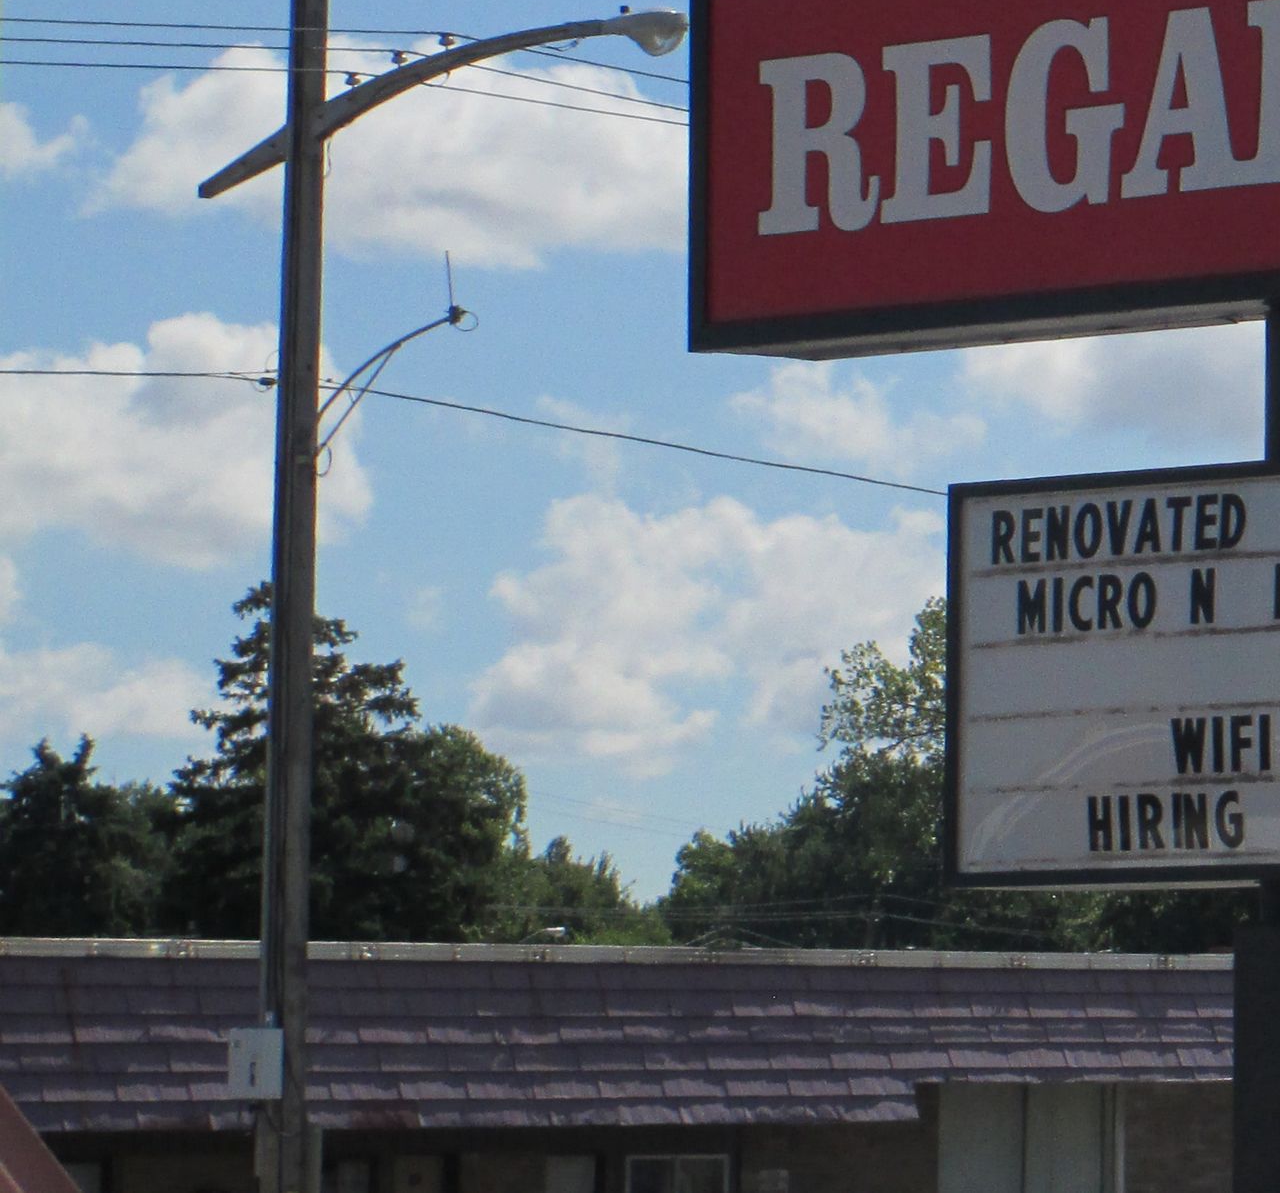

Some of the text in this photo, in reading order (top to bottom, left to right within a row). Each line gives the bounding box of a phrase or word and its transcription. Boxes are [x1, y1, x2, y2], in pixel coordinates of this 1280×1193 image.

[992, 493, 1246, 565] RENOVATED
[1017, 571, 1157, 634] MICRO
[1190, 568, 1215, 624] N
[1171, 714, 1272, 774] WIFI
[1087, 791, 1245, 852] HIRING
